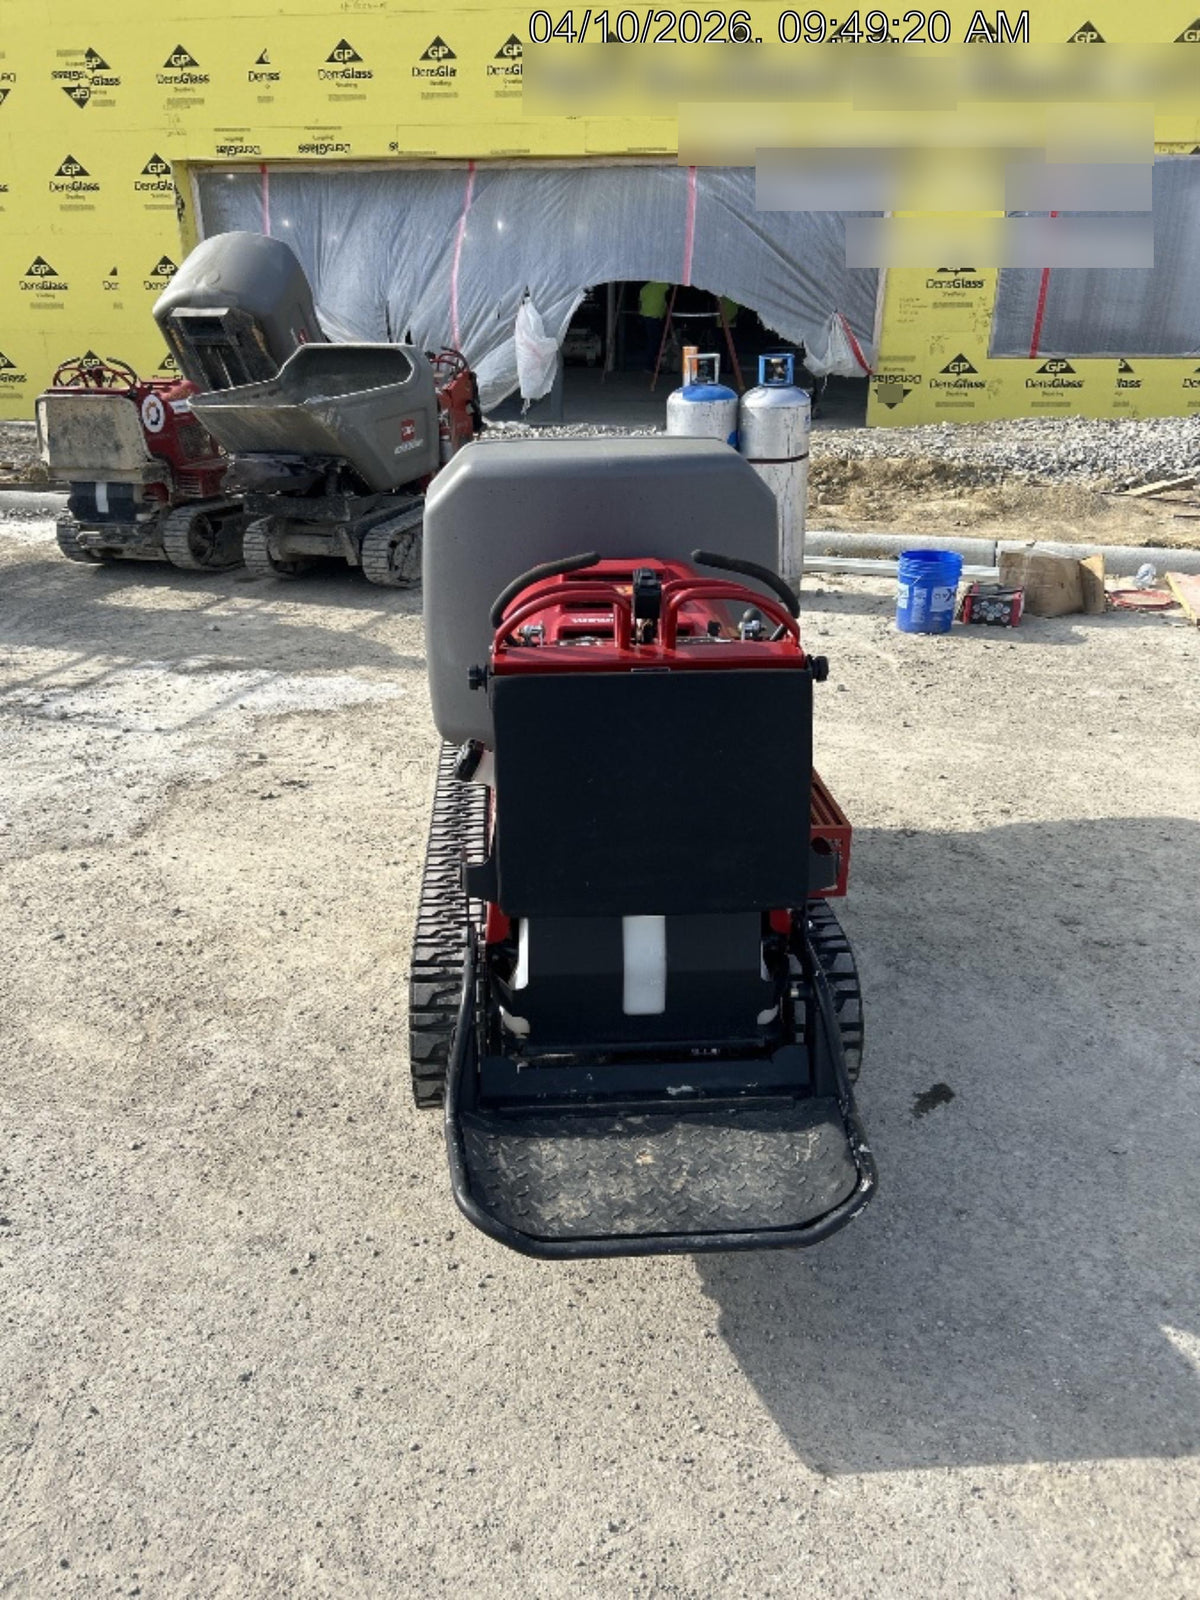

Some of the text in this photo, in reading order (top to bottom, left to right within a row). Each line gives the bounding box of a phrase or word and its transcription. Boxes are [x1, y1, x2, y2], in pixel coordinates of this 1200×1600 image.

[1074, 32, 1098, 43] GP
[334, 49, 353, 60] GP
[428, 46, 449, 58] GP
[171, 54, 190, 66] GP
[156, 72, 210, 84] DensGlass
[318, 67, 373, 80] DensGlass
[61, 164, 81, 175] GP
[147, 163, 166, 173] GP
[49, 181, 100, 191] DensGlass
[31, 264, 49, 274] GP
[157, 264, 175, 274] GP
[19, 280, 69, 291] DensGlass
[925, 277, 984, 289] DensGlass
[949, 362, 970, 373] GP
[1045, 362, 1067, 373] GP
[929, 378, 986, 389] DensGlass
[1025, 378, 1084, 389] DensGlass
